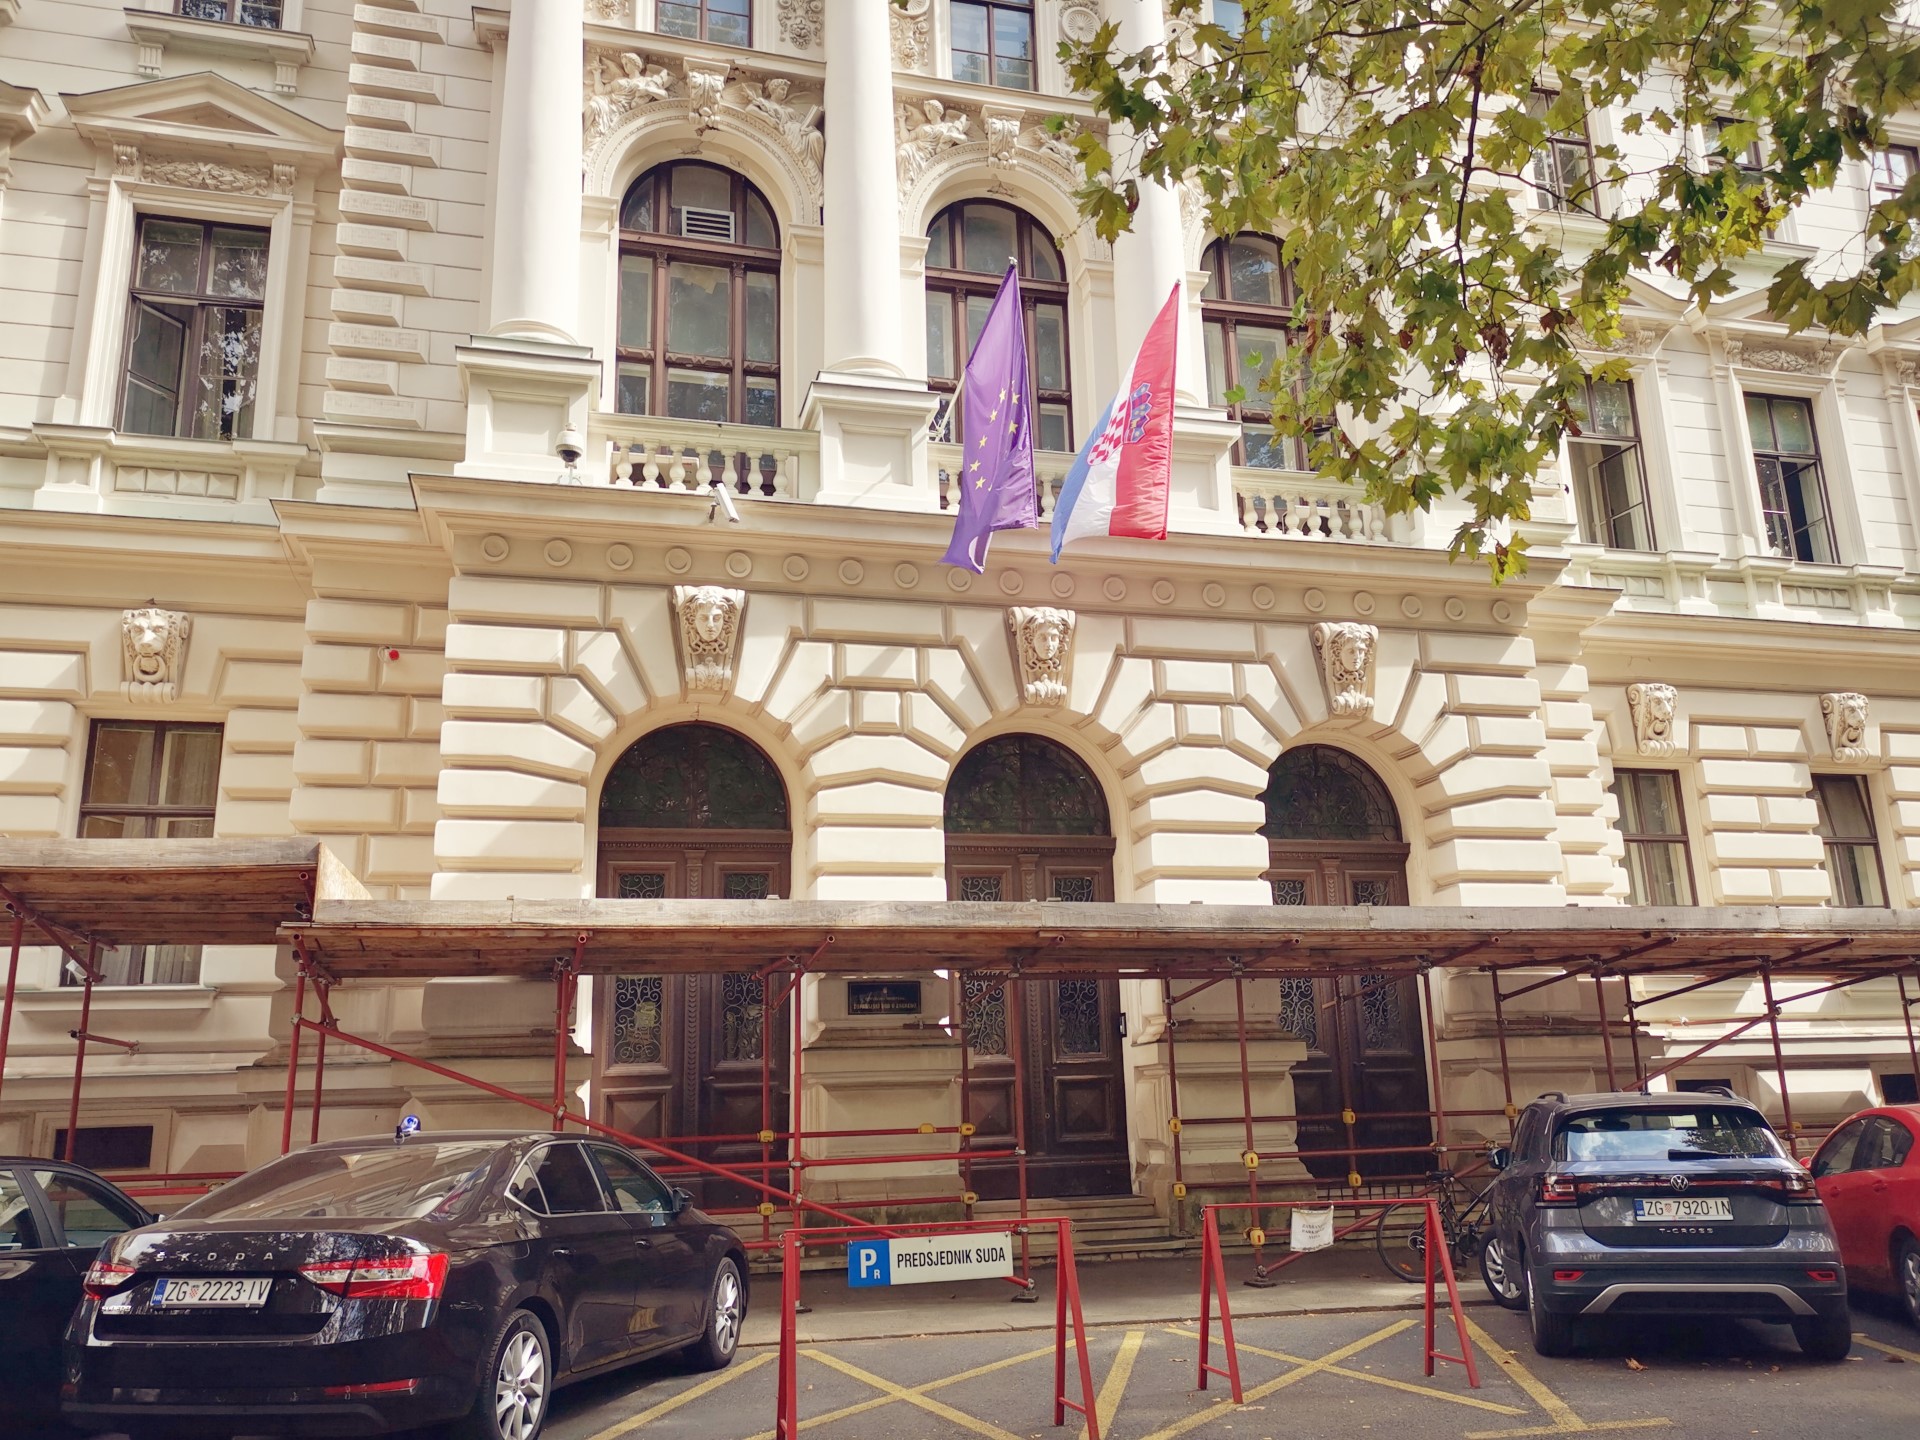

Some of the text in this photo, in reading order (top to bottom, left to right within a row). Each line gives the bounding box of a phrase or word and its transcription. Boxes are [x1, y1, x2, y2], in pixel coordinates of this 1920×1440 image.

[1645, 1201, 1664, 1215] ZG
[860, 1249, 877, 1278] P
[897, 1247, 1006, 1269] PREDSJEDNIK SUDA
[874, 1269, 881, 1279] R
[165, 1281, 189, 1301] ZG
